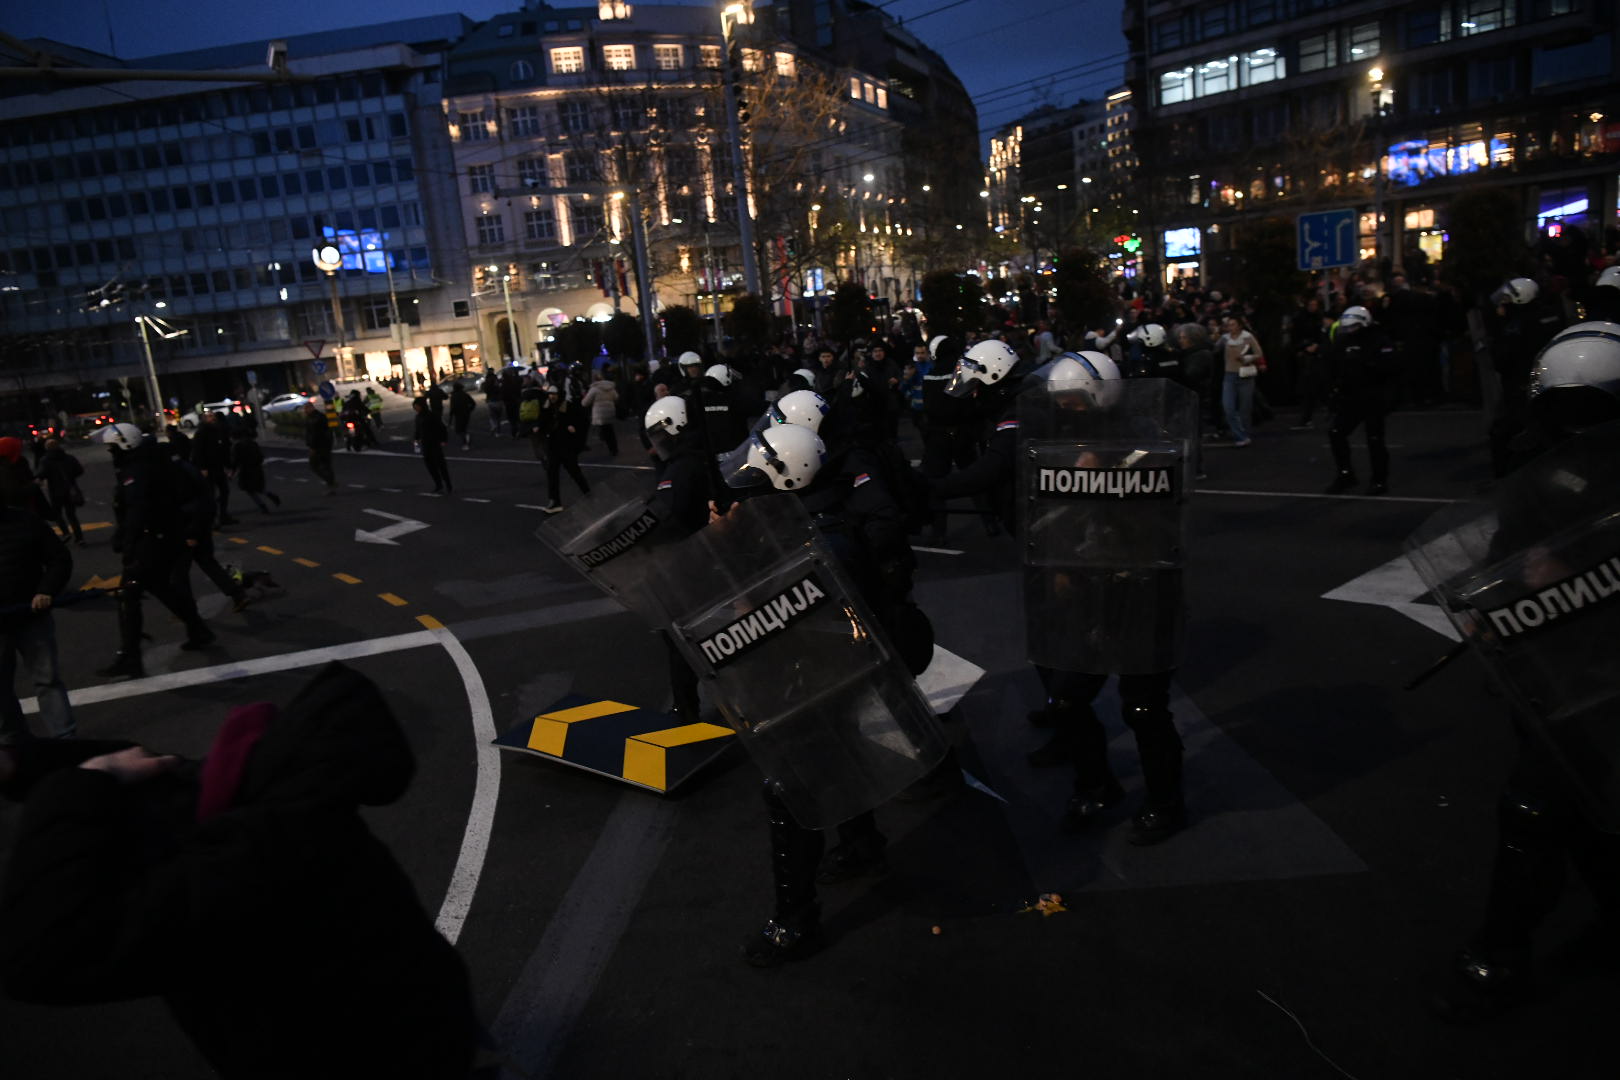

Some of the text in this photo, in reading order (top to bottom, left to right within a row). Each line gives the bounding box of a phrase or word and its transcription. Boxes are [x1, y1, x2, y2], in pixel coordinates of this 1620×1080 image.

[1040, 458, 1171, 498] ПОЛИЦИЈА
[580, 514, 657, 566] ПОЛИЦИЈА
[700, 578, 827, 664] ПОЛИЦИЈА
